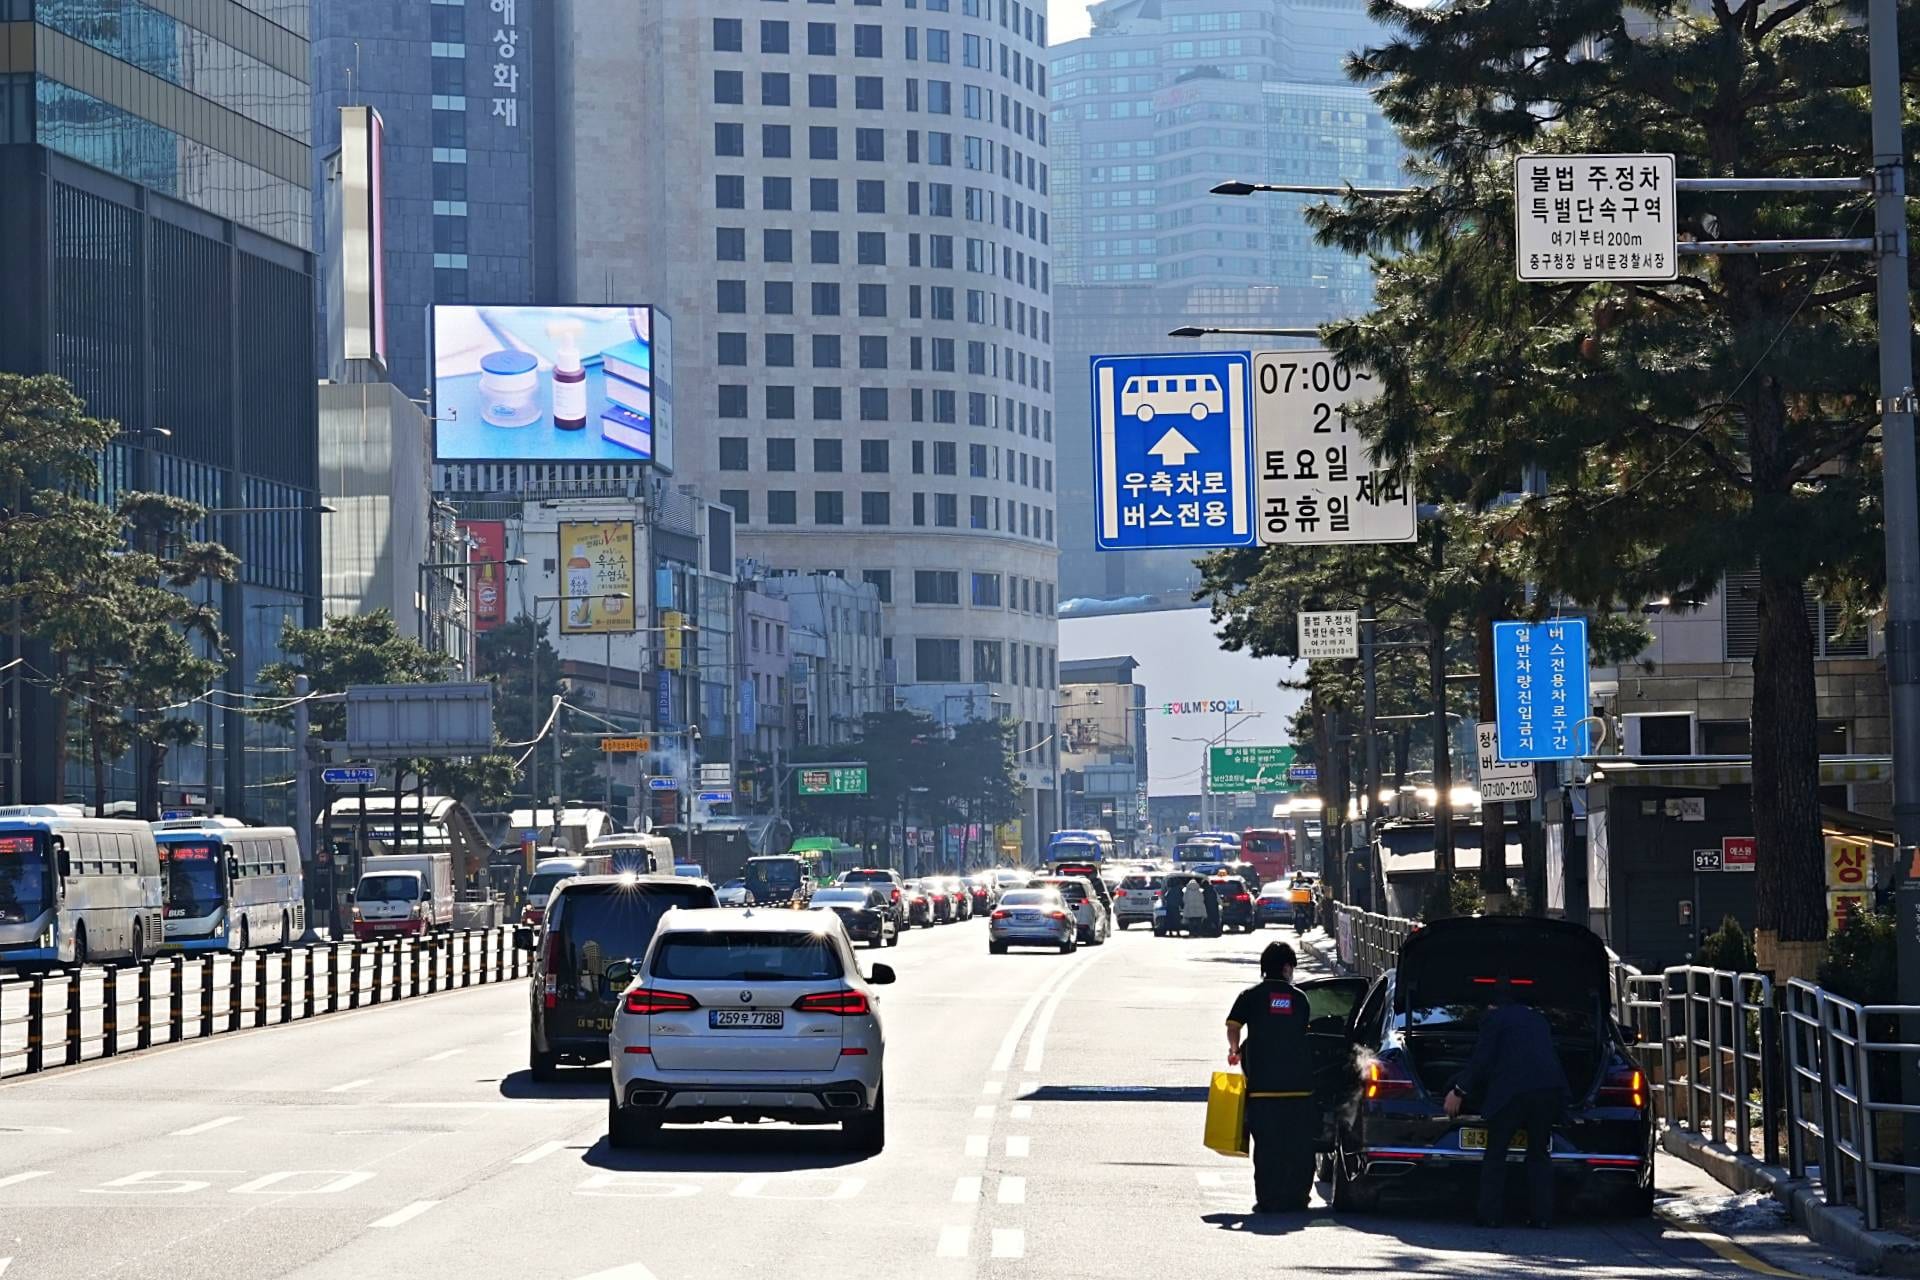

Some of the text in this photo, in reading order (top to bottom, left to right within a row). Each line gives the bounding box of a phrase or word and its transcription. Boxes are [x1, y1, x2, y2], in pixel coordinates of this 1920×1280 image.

[490, 0, 519, 127] 해상화재
[1530, 164, 1660, 192] 불법 주.정차
[1531, 197, 1661, 224] 특별단속구역
[1530, 253, 1664, 270] 중구청장 남대문경찰서장
[1263, 445, 1348, 482] 토요일
[1123, 471, 1227, 498] 우측차로
[1123, 501, 1227, 529] 버스전용
[1264, 495, 1350, 533] 공휴일
[1515, 628, 1534, 751] 일반차량진입금지
[1549, 626, 1569, 750] 버스전용차로구간
[1696, 856, 1720, 866] 91-2
[1271, 999, 1291, 1008] LEGO
[751, 1010, 781, 1025] 7788
[79, 1171, 378, 1194] 50
